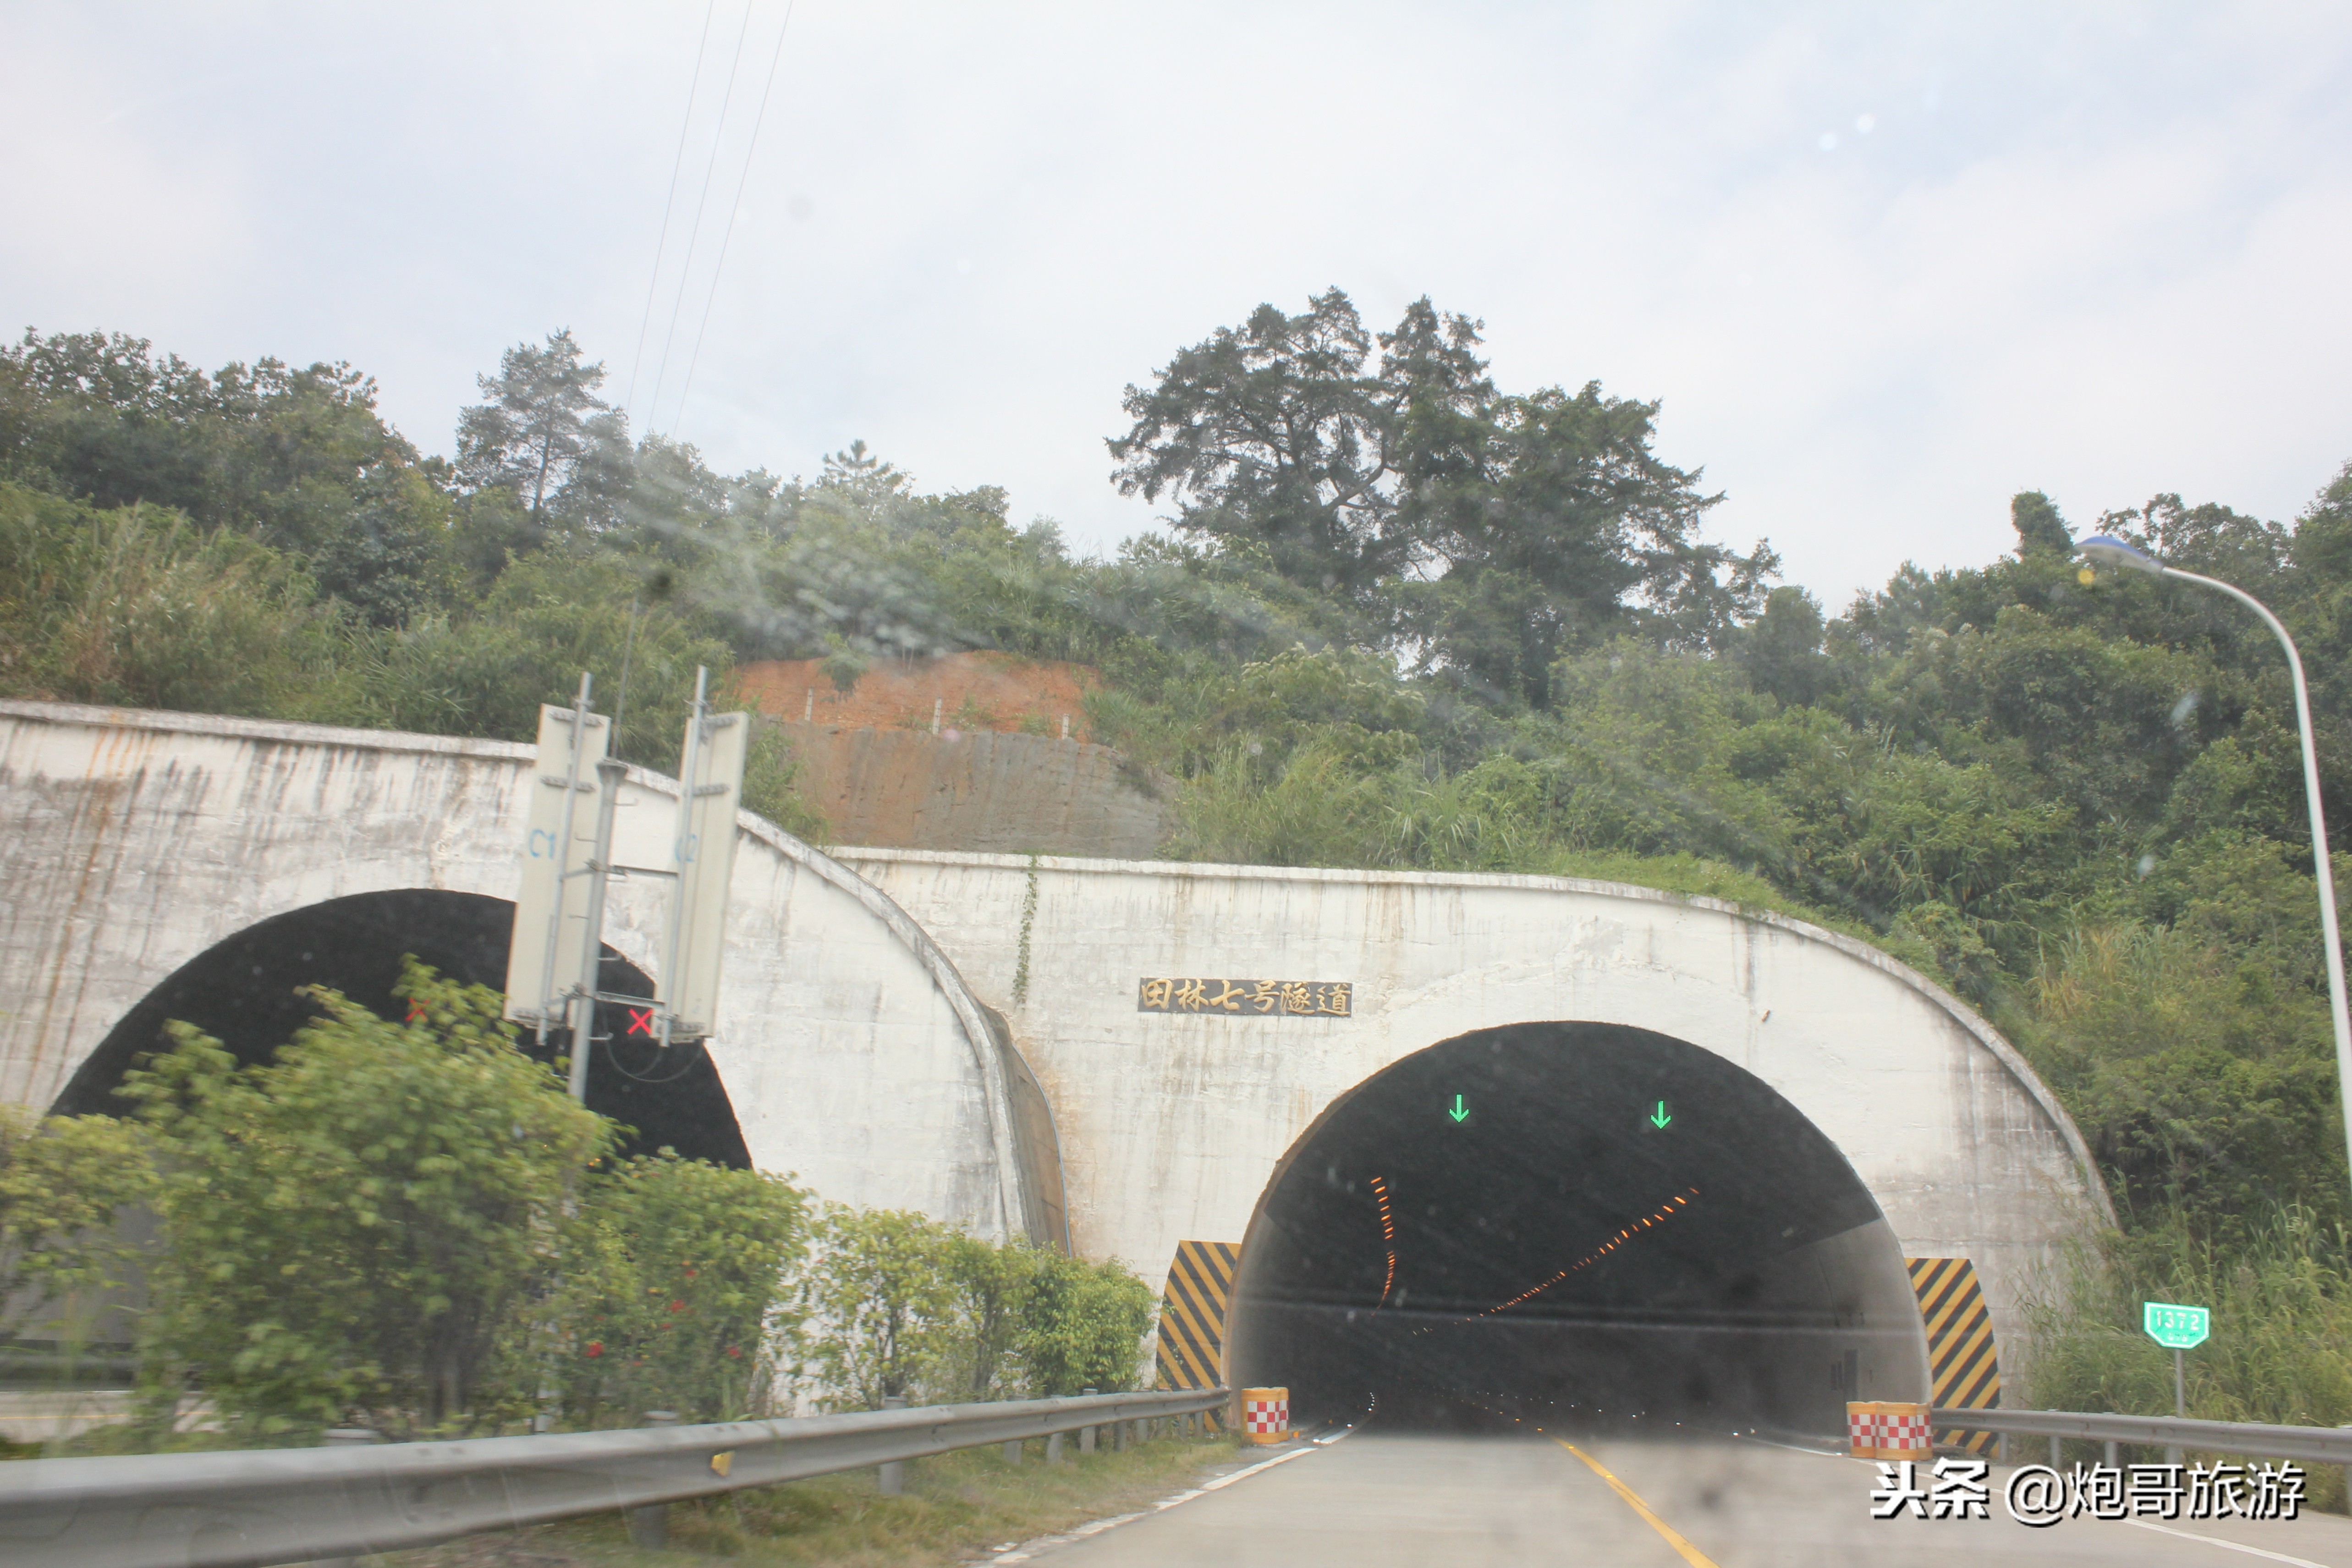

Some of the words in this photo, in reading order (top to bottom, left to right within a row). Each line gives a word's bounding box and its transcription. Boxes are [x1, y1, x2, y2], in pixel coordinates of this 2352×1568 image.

[1141, 979, 1351, 1016] 田林七号隧道
[2156, 1310, 2199, 1331] 1372
